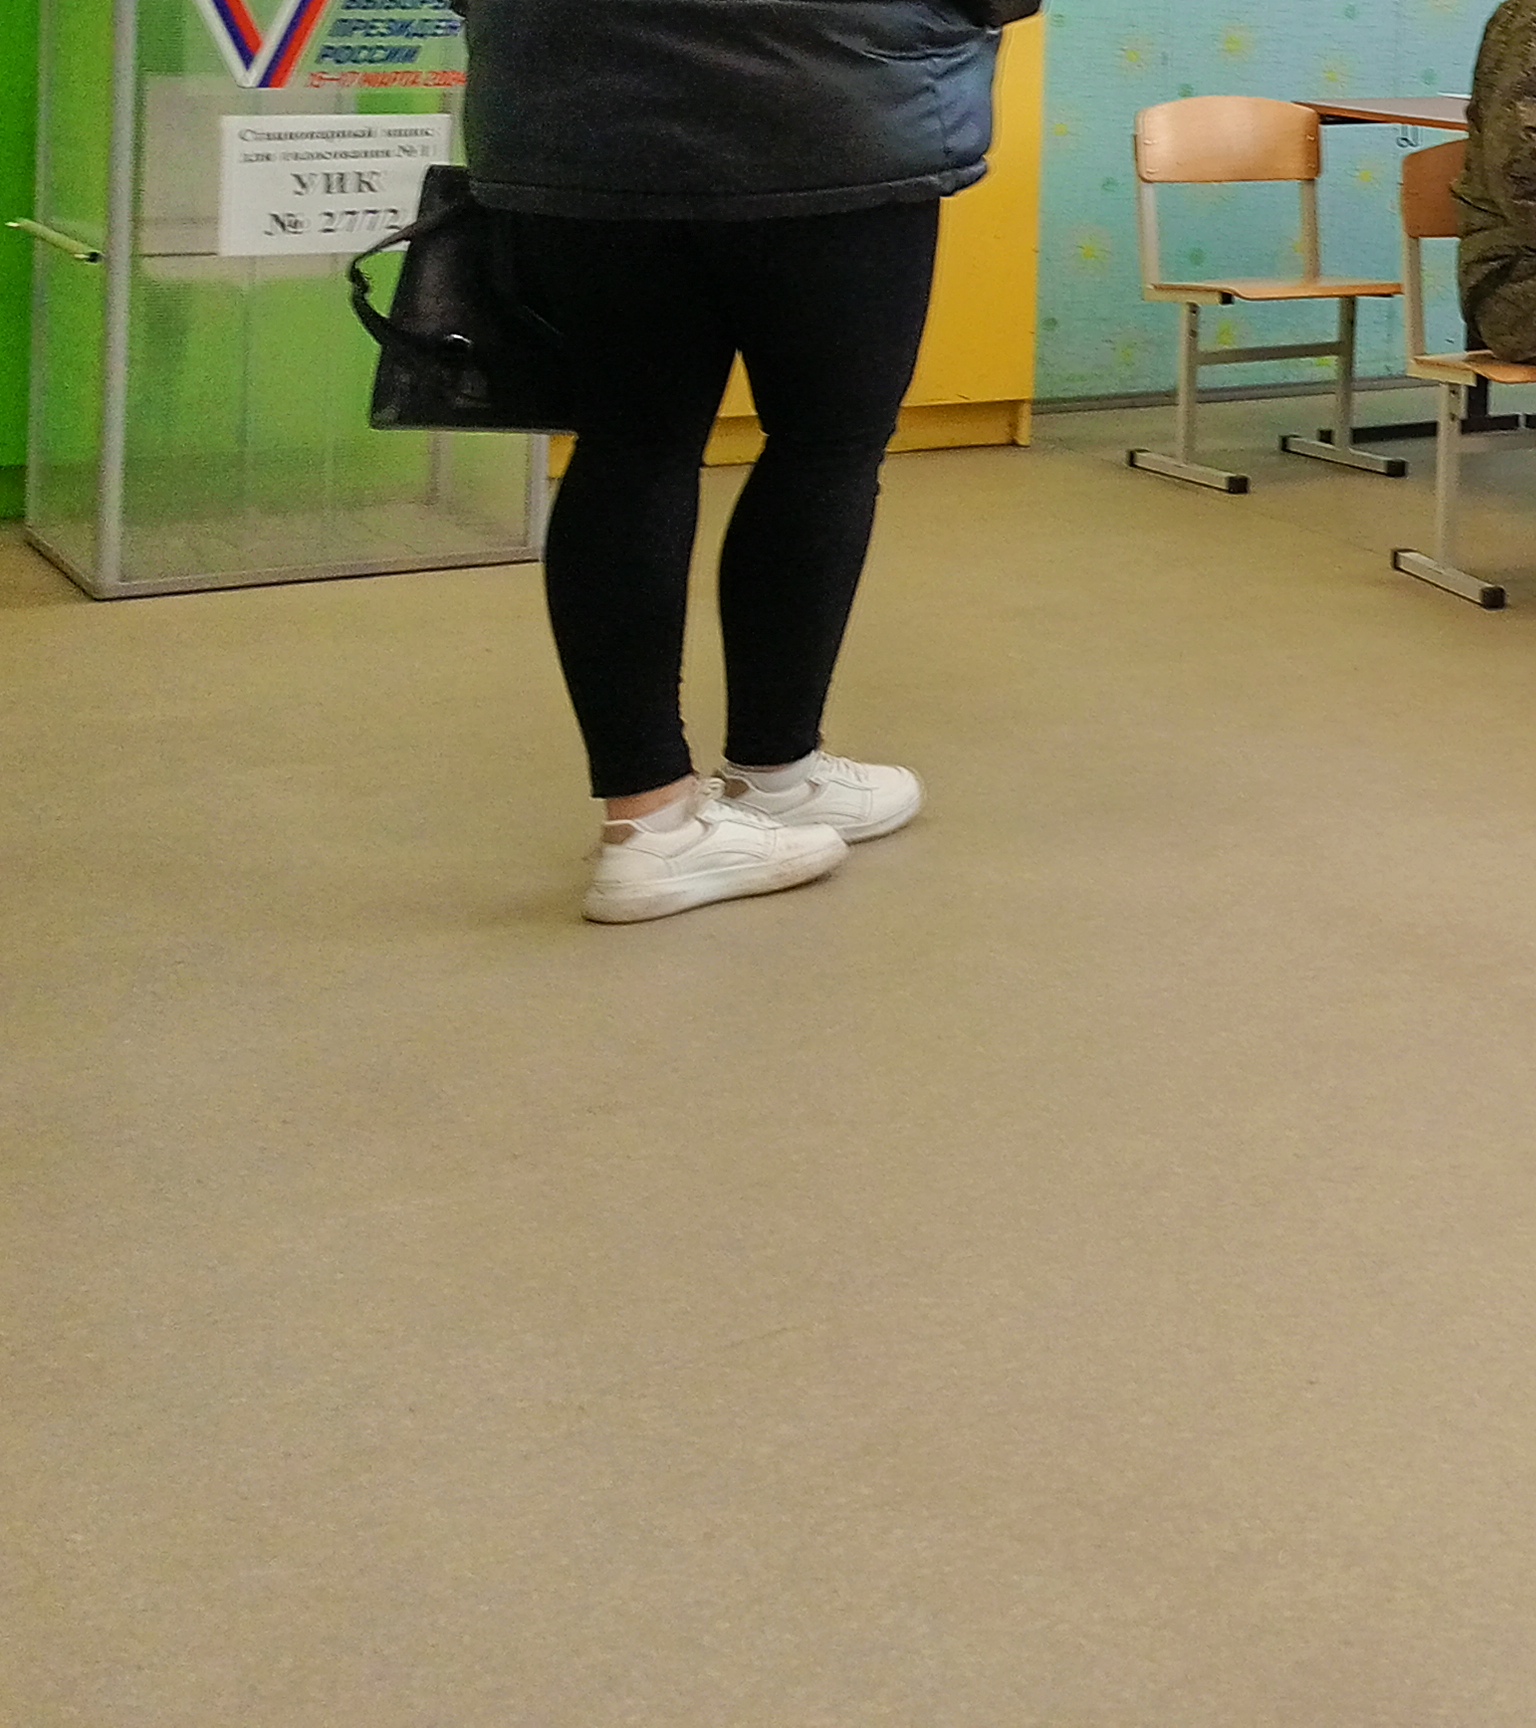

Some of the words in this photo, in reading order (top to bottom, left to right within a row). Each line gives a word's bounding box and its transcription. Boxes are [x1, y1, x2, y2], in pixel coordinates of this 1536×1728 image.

[314, 44, 421, 64] РОССИИ
[238, 127, 374, 142] Стационарный
[290, 171, 382, 196] УИК
[318, 208, 402, 233] 2772
